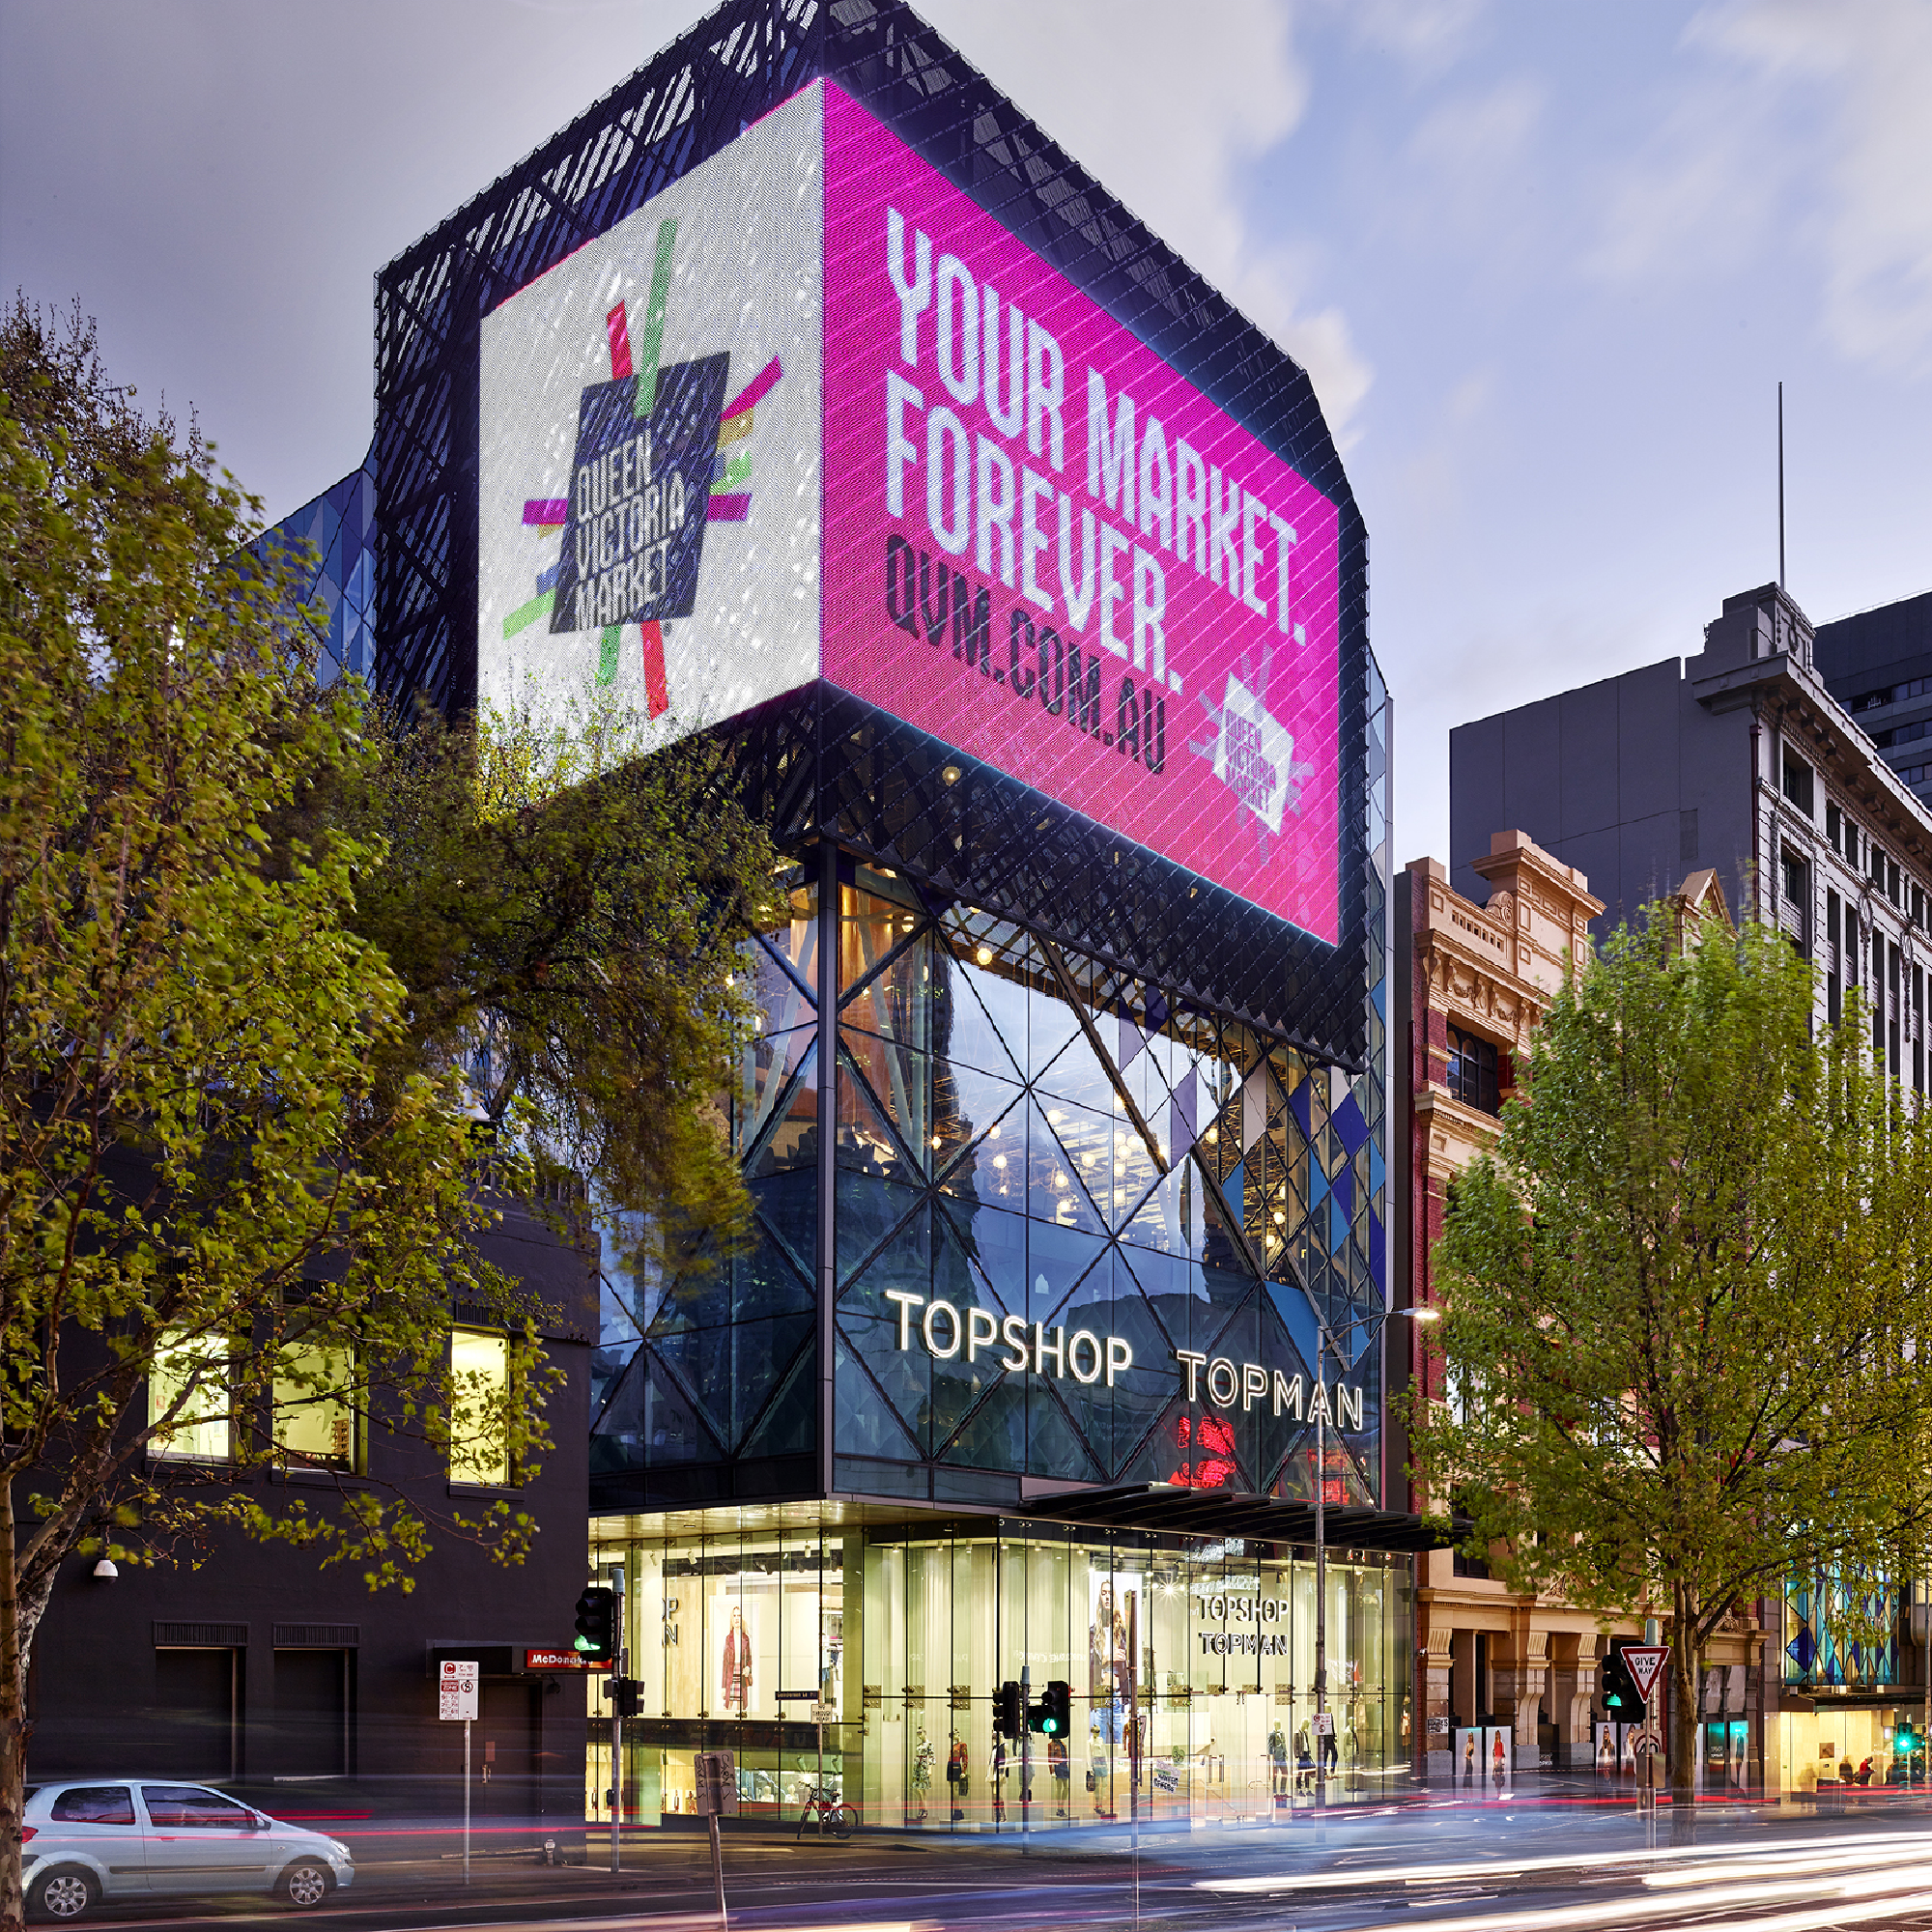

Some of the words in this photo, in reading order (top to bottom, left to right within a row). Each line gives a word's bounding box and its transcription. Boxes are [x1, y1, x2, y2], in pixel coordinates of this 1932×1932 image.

[888, 206, 1064, 473] YOUR
[1088, 365, 1305, 647] MARKET.
[578, 428, 651, 523] QUEEN
[576, 470, 685, 580] VICTORIA
[887, 368, 1183, 695] FOREVER.
[576, 537, 671, 631] MARKET
[887, 535, 1164, 773] QVM.COM.AU
[885, 1290, 1133, 1387] TOPSHOP
[1176, 1349, 1363, 1432] TOPMAN
[1197, 1595, 1289, 1622] TOPSHOP
[1199, 1632, 1288, 1656] TOPMAN
[1634, 1657, 1656, 1666] GIVE
